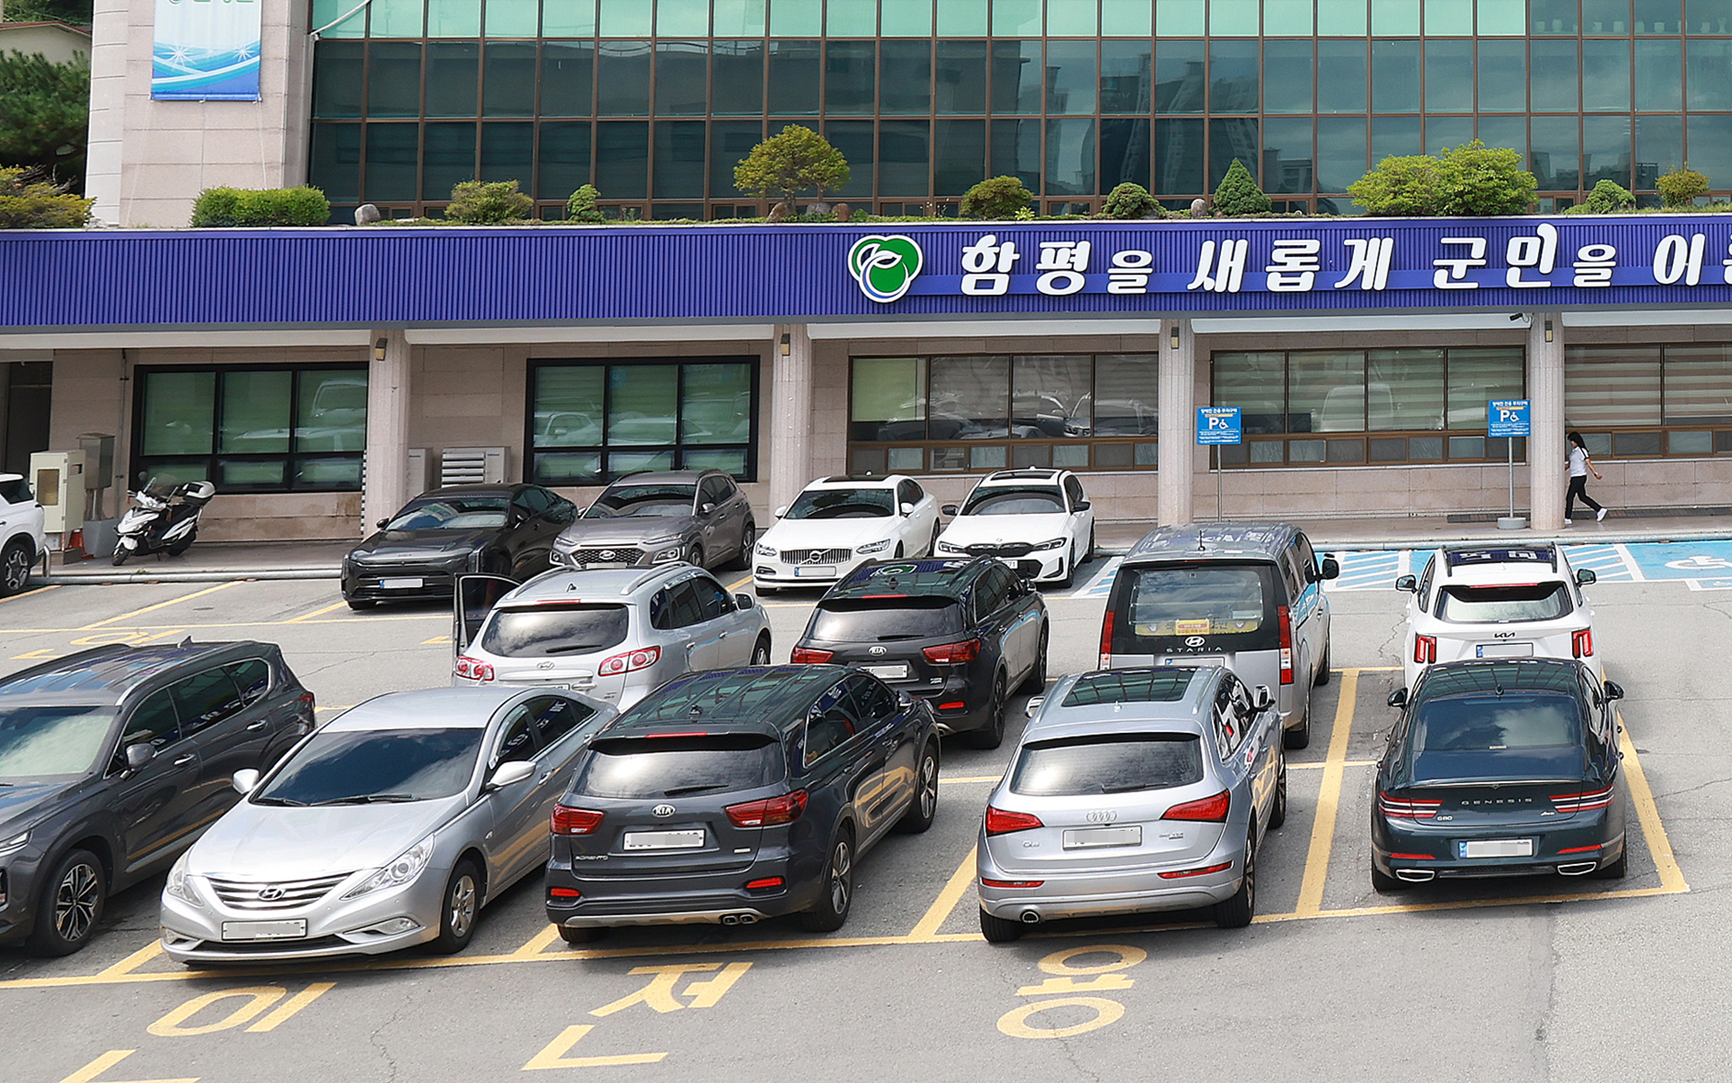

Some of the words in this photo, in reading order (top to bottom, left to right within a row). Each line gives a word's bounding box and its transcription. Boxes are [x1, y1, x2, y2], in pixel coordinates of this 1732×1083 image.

[960, 234, 1154, 296] 함평을
[1186, 236, 1395, 294] 새롭게
[1432, 222, 1618, 290] 군민을
[653, 804, 676, 817] KIA
